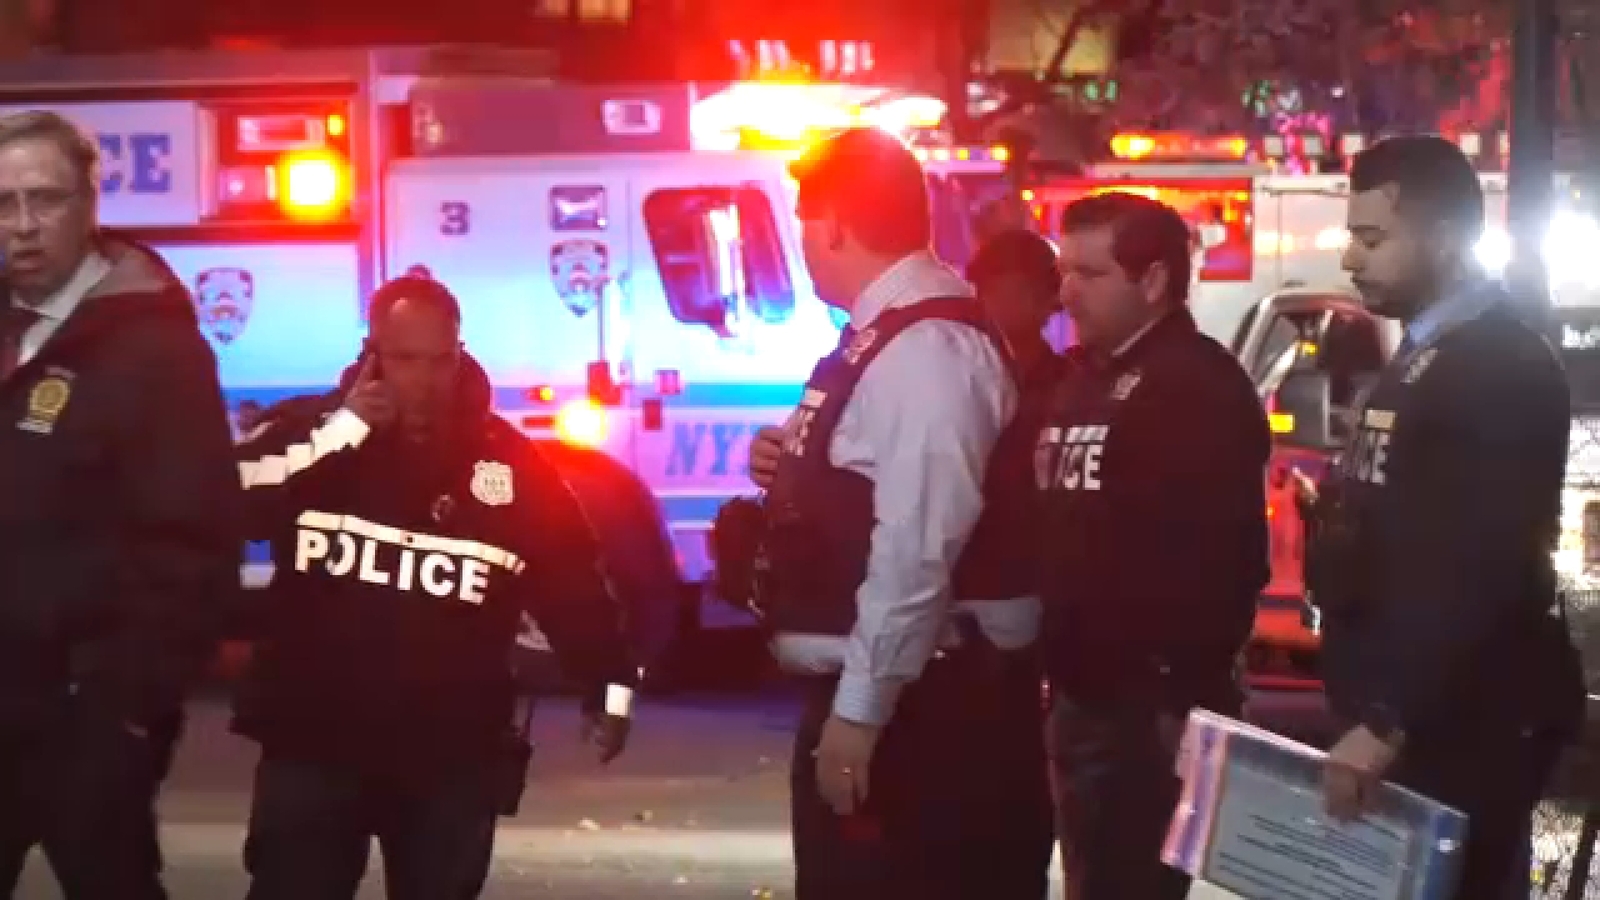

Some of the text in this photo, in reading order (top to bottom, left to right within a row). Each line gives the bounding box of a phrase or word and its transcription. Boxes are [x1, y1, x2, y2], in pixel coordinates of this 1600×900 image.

[441, 202, 470, 235] 3
[664, 424, 762, 476] NY
[294, 529, 490, 604] POLICE
